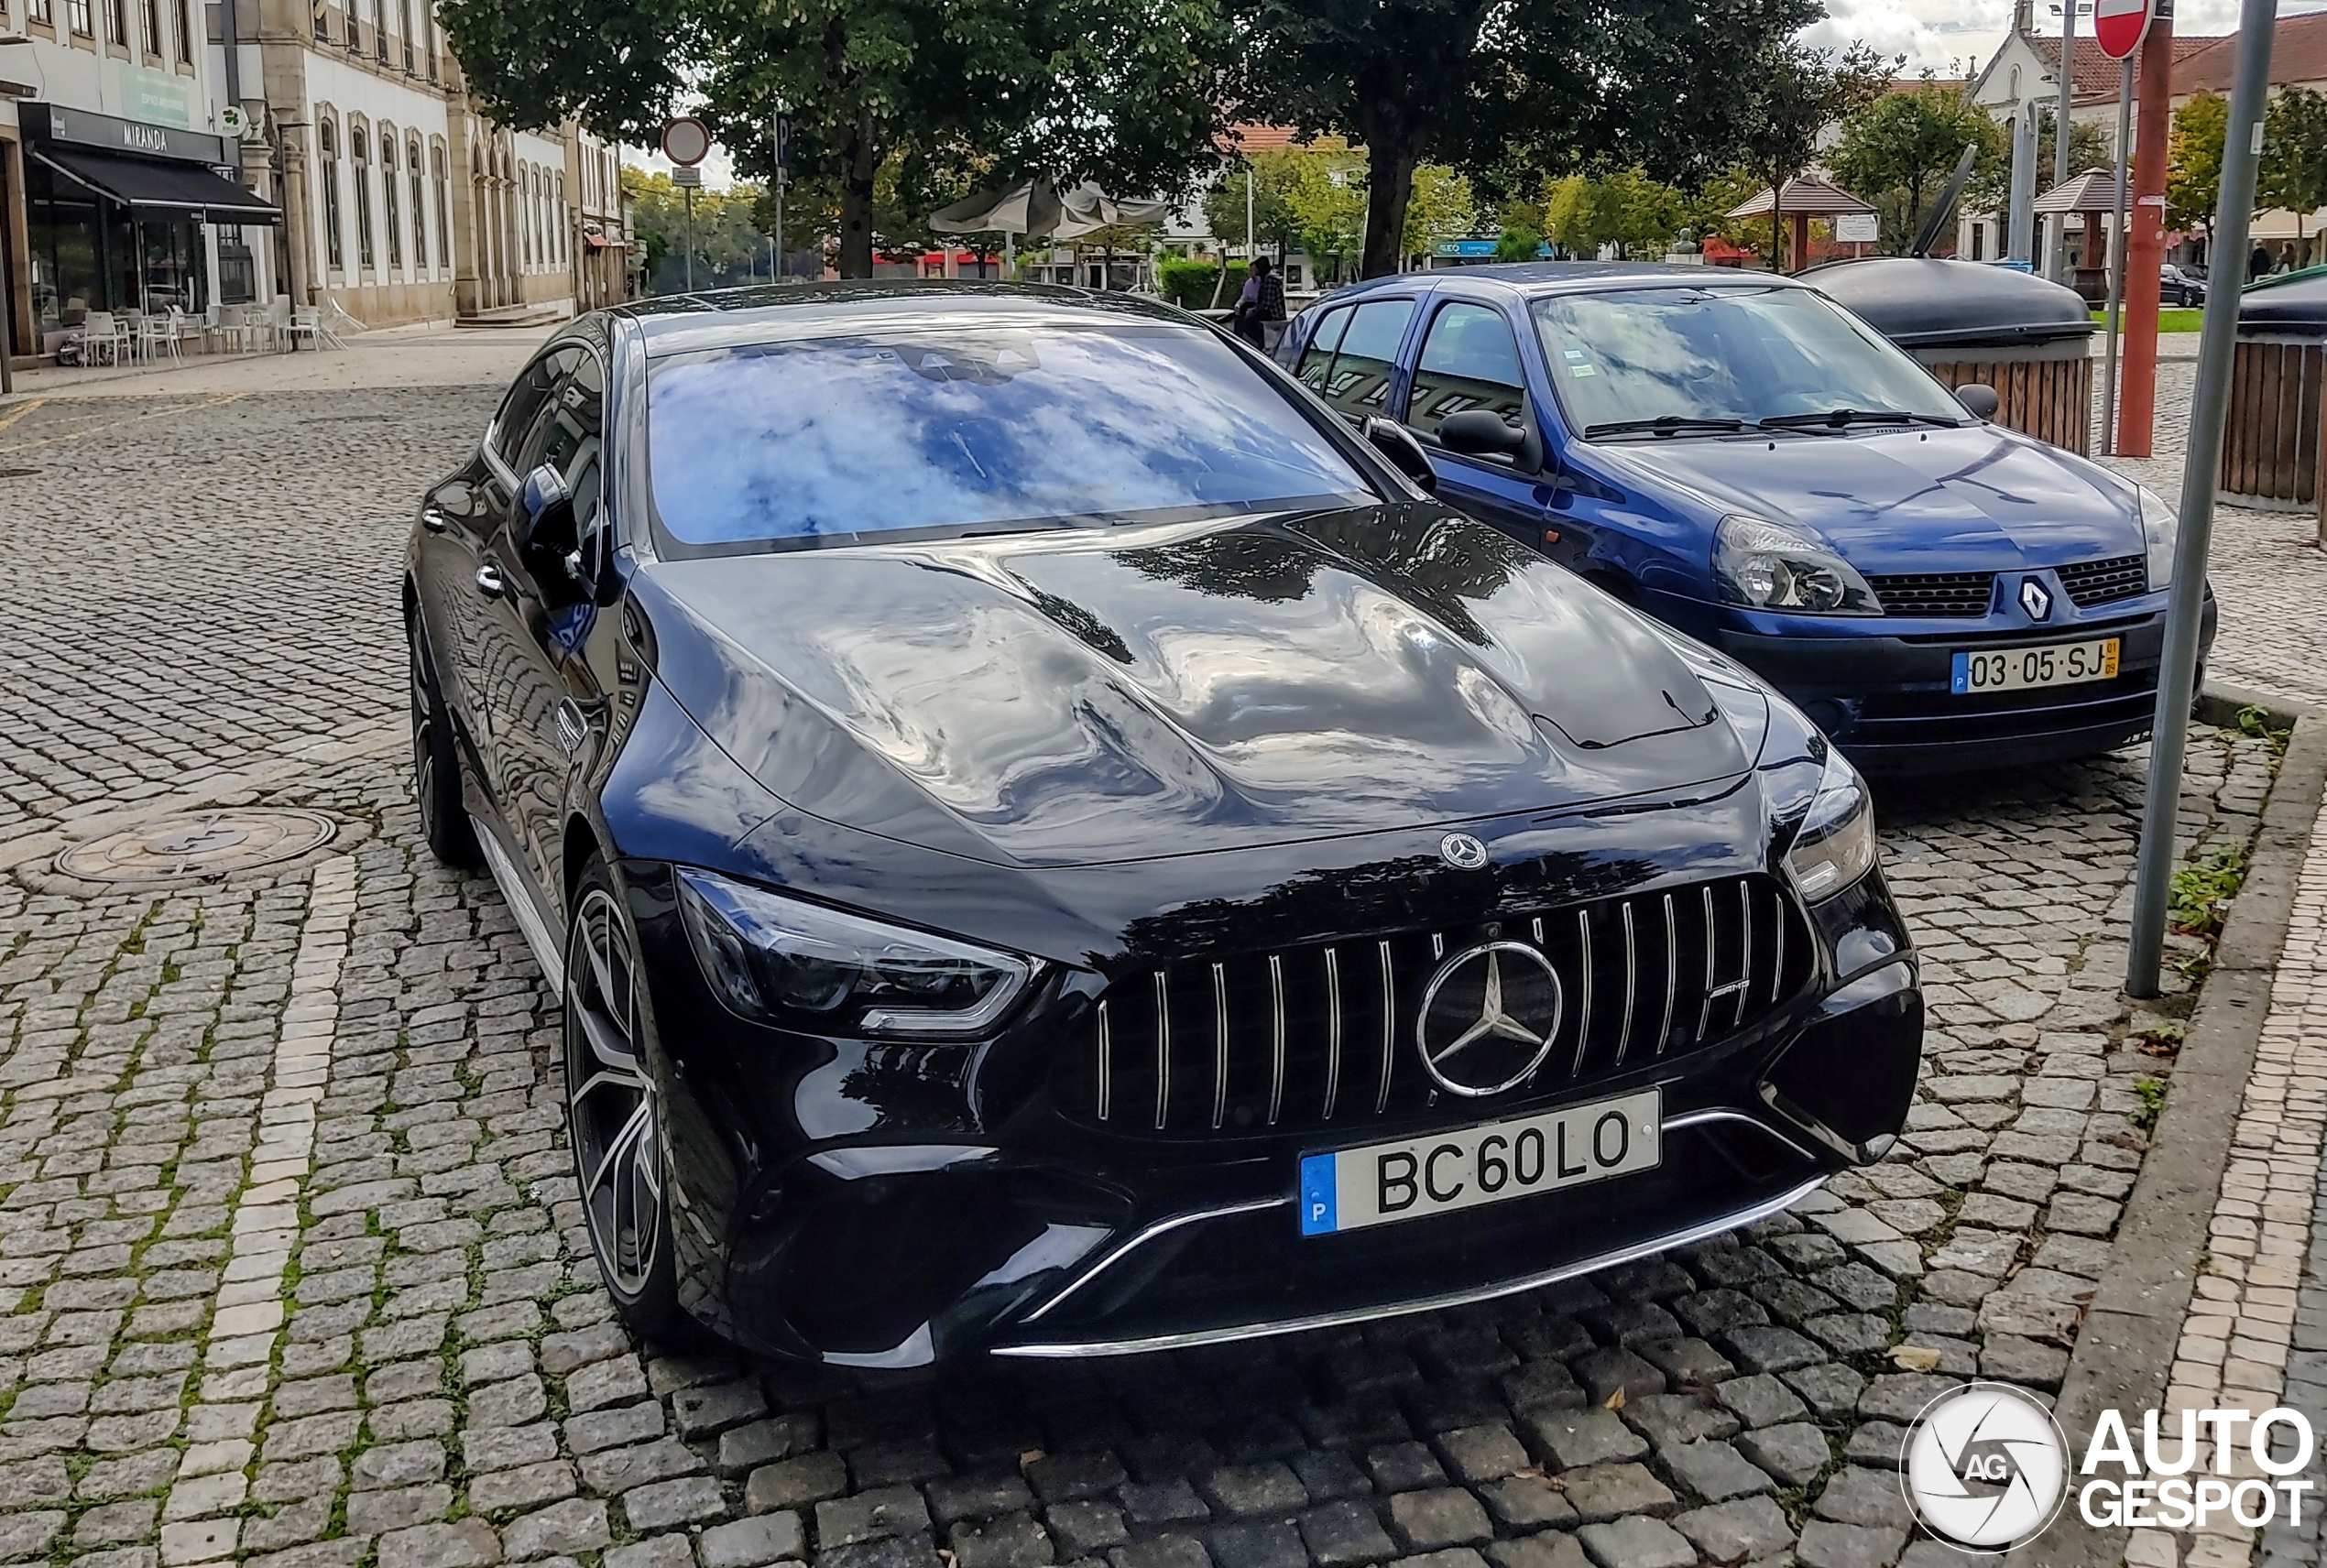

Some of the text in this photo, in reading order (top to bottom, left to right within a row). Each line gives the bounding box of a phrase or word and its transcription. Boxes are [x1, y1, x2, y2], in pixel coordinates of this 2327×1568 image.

[124, 124, 168, 151] MIRANDA
[780, 118, 789, 159] P
[2106, 642, 2116, 654] 01
[2105, 663, 2116, 675] 09
[1956, 677, 1964, 687] P
[1313, 1203, 1327, 1222] P
